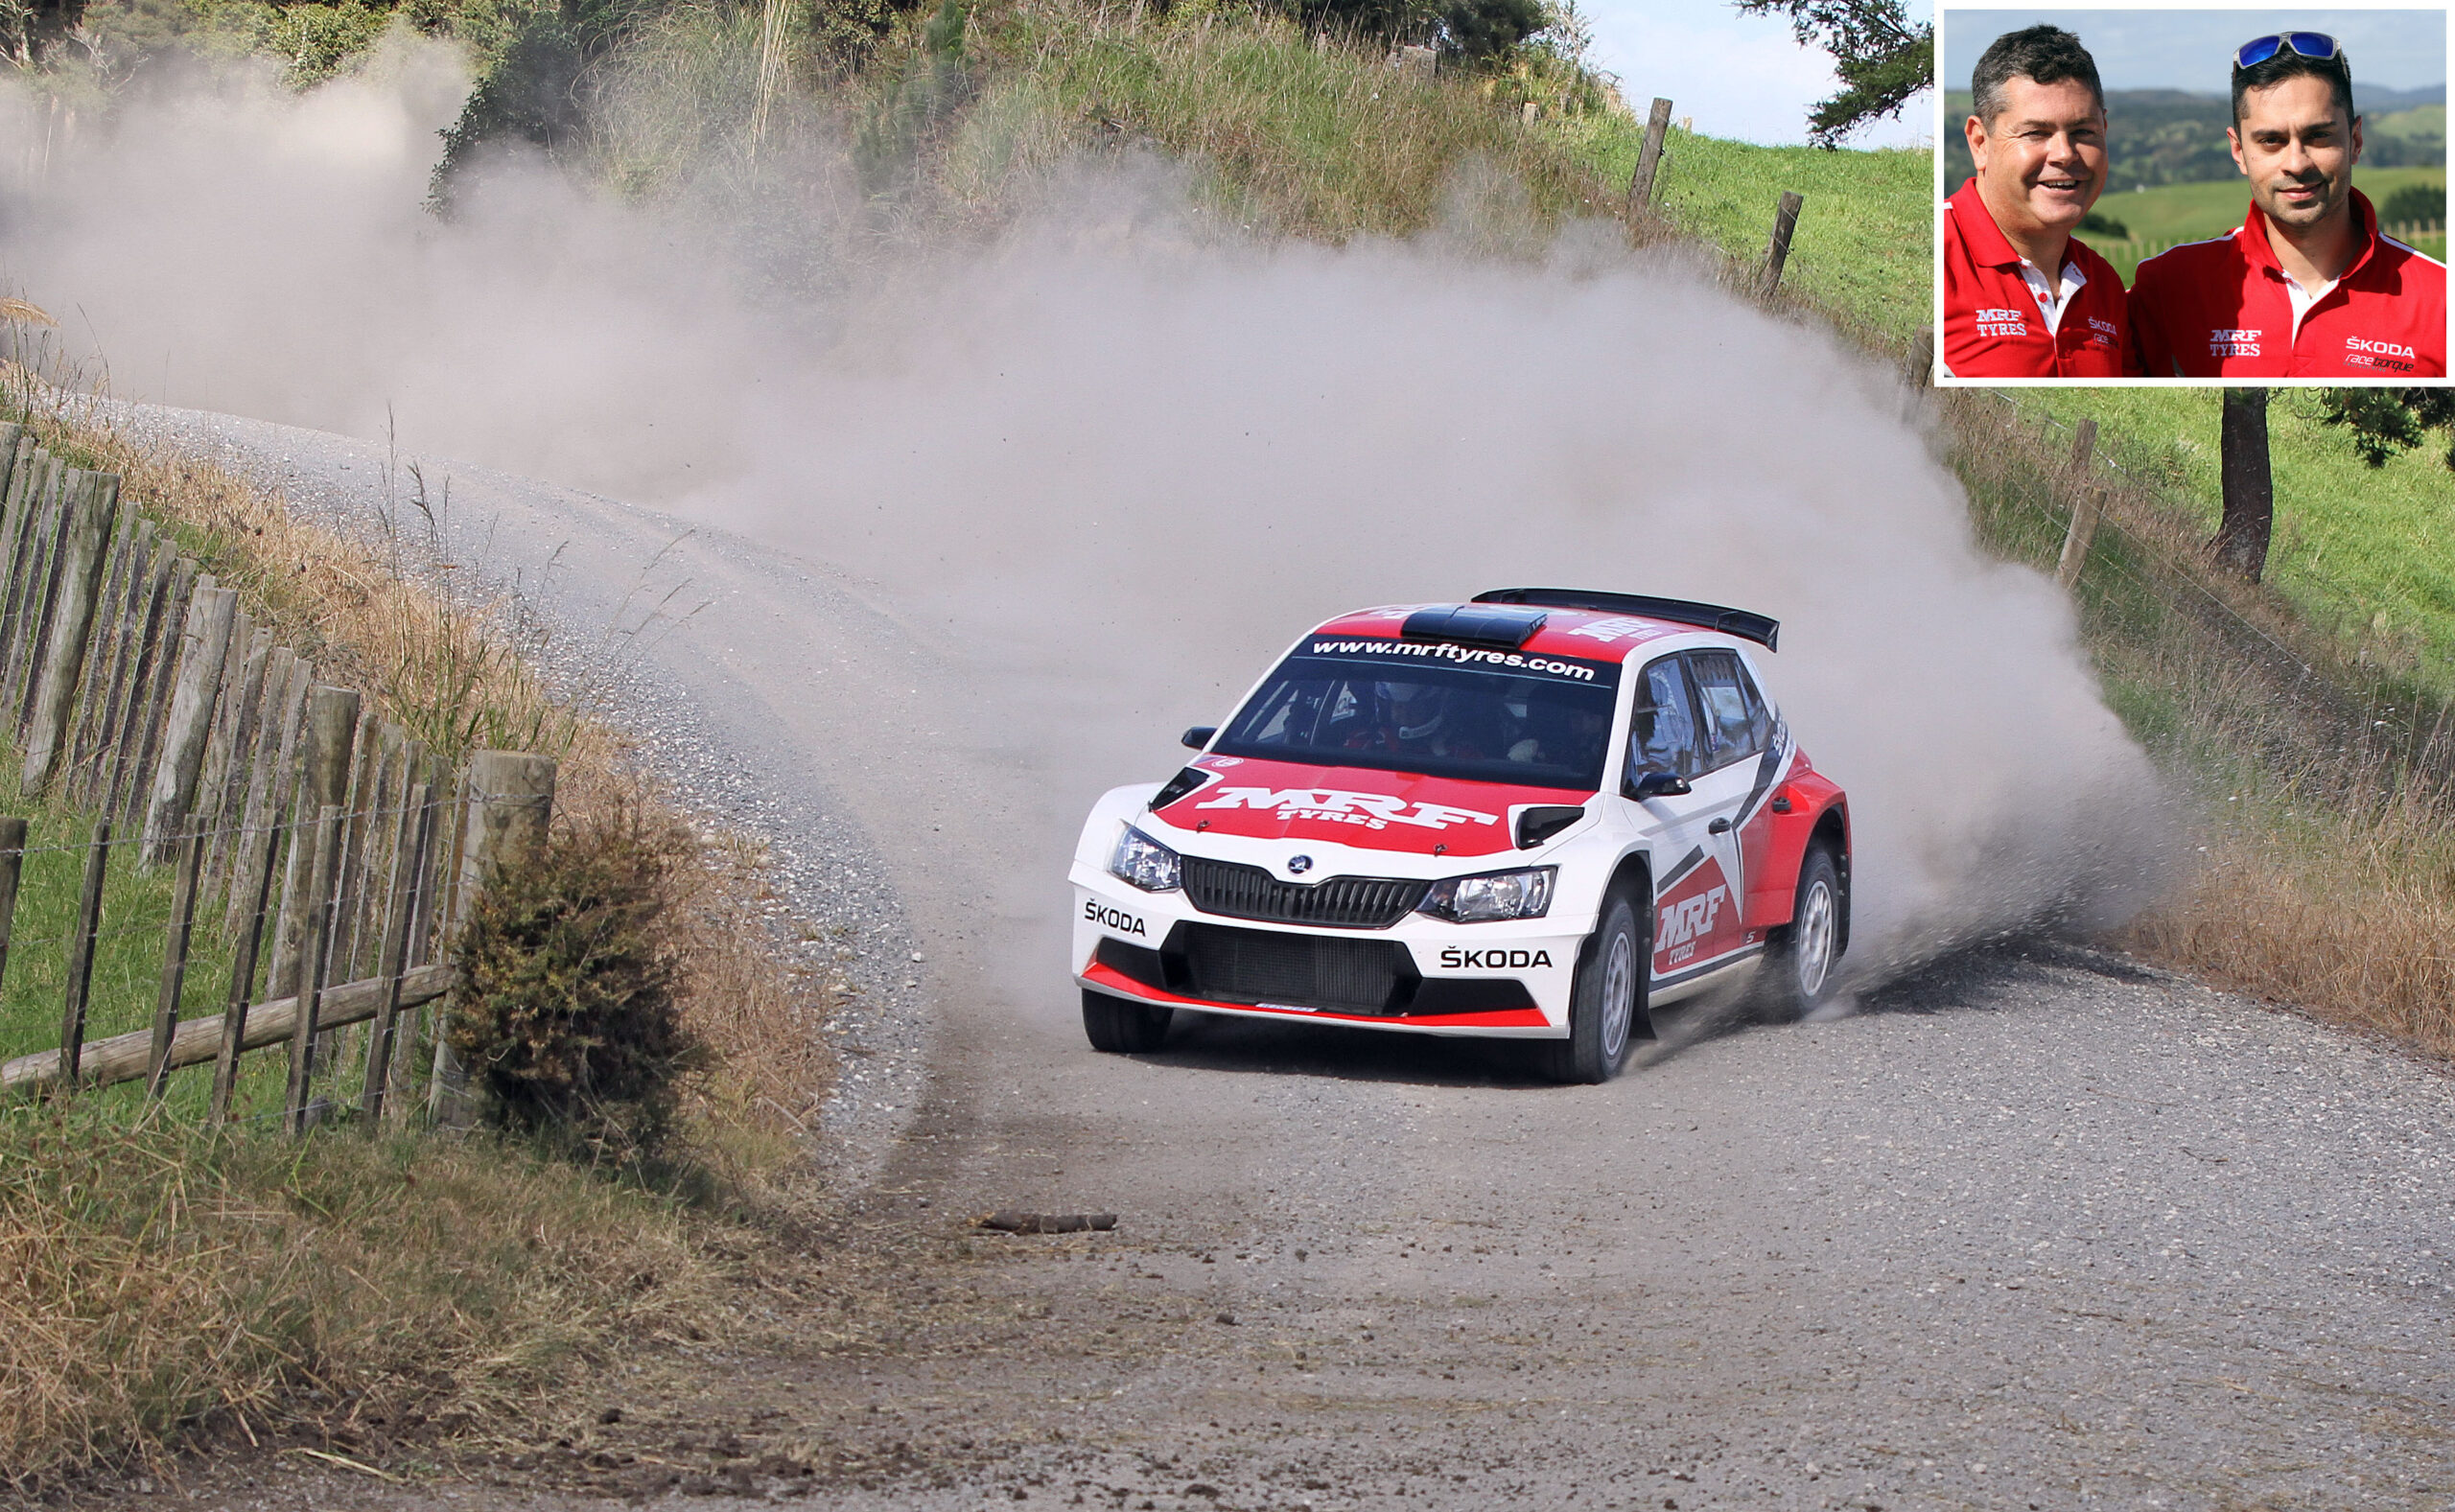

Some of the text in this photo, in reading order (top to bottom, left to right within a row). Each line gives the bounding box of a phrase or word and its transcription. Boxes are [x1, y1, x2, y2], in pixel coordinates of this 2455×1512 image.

[1976, 308, 2022, 322] MRF
[1976, 322, 2027, 337] TYRES
[2210, 329, 2262, 342] MRF
[2210, 343, 2261, 357] TYRES
[2345, 336, 2415, 359] ŠKODA
[1312, 640, 1595, 681] www.mrftyres.com
[1195, 787, 1500, 830] MRF
[1276, 808, 1389, 830] TYRES
[1084, 897, 1146, 937] ŠKODA
[1654, 884, 1726, 954] MRF
[1440, 945, 1553, 968] ŠKODA
